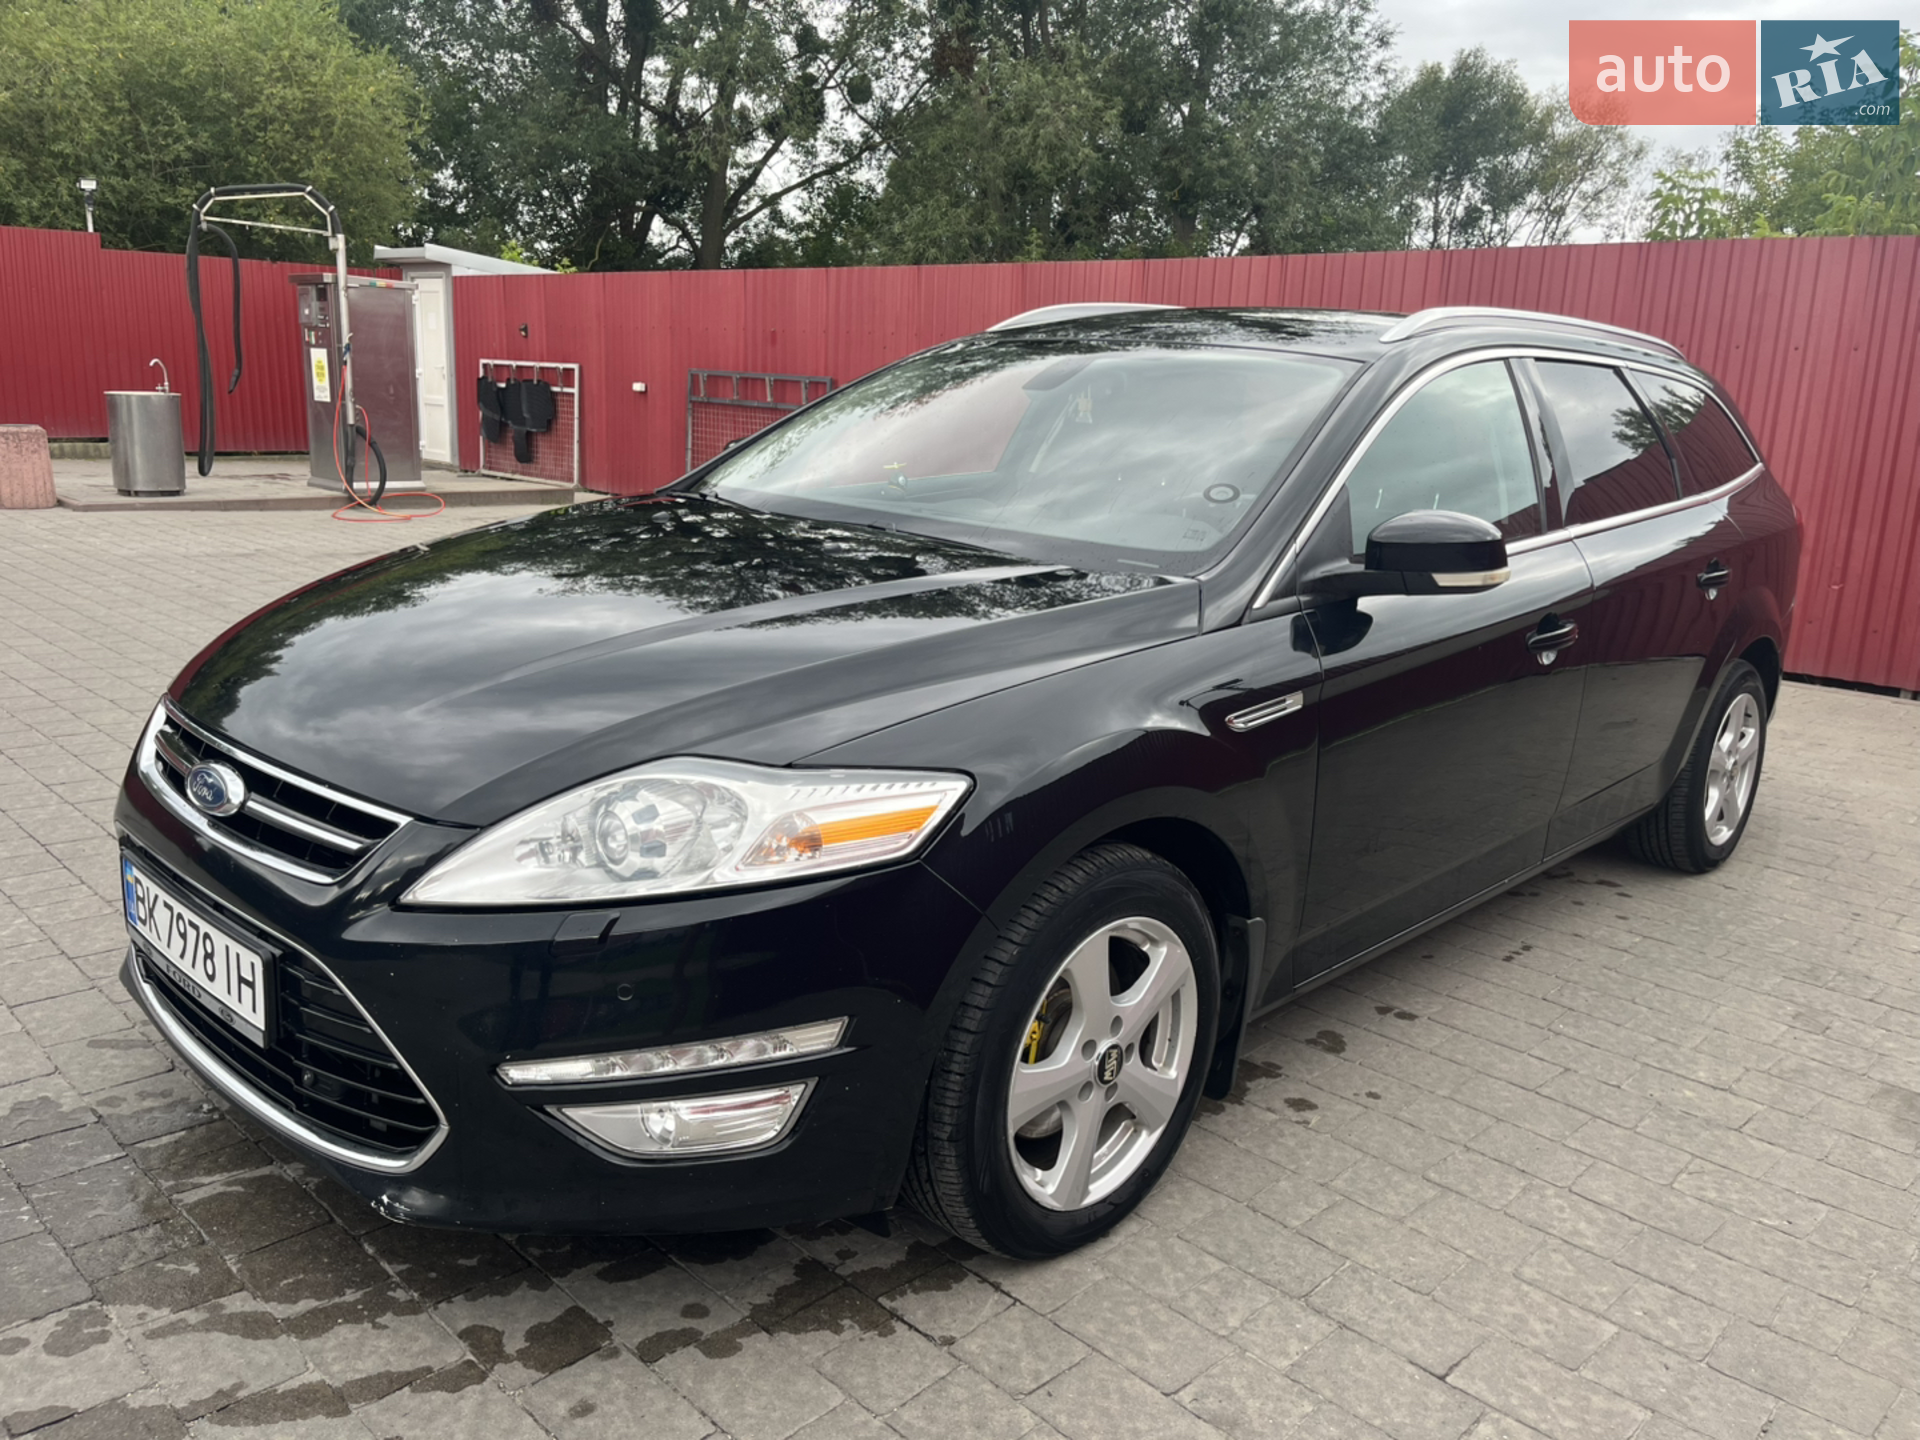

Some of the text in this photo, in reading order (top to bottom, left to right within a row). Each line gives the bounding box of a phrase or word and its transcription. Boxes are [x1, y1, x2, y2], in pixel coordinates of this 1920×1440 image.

[135, 875, 257, 1015] BK 7978 IH
[165, 963, 202, 1000] FORD
